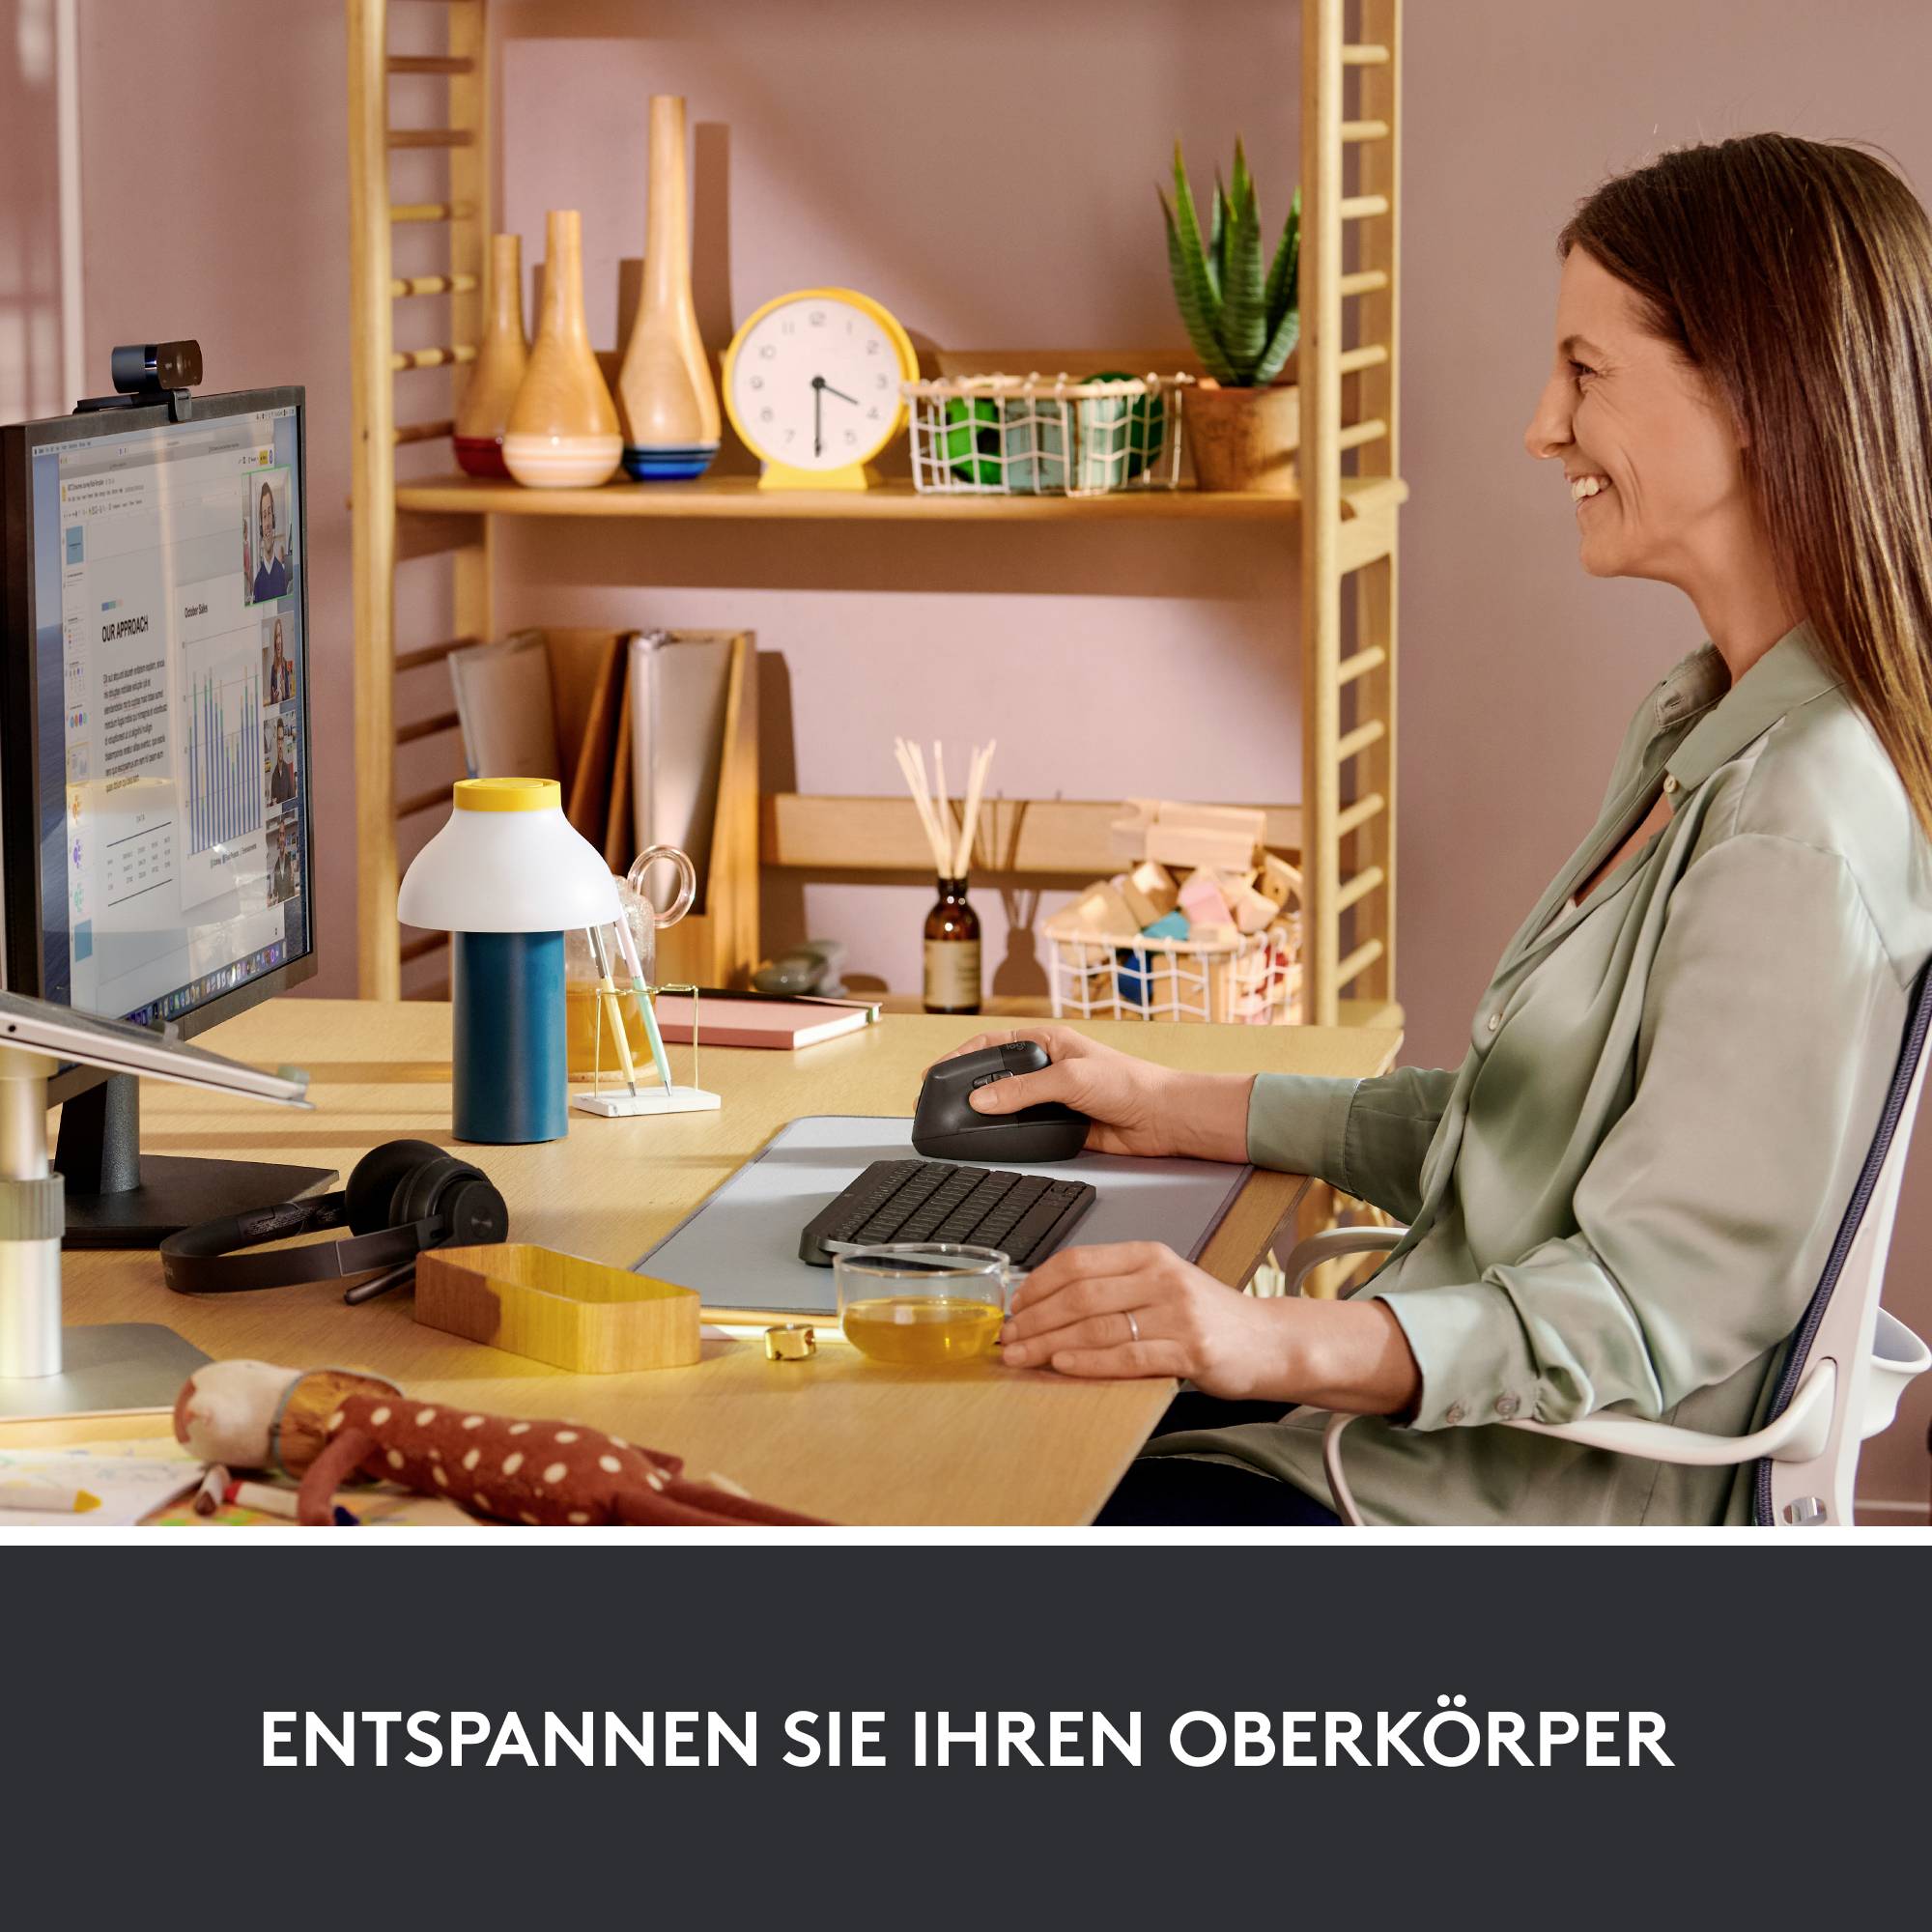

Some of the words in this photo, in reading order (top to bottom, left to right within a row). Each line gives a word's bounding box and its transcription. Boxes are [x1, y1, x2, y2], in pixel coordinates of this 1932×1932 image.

[867, 340, 880, 355] 2
[751, 376, 764, 390] 9
[876, 375, 888, 389] 3
[785, 429, 796, 443] 7
[185, 606, 198, 618] October
[198, 604, 208, 615] Sales
[101, 624, 115, 642] OUR
[116, 614, 149, 639] APPROACH
[1007, 1041, 1026, 1051] logi
